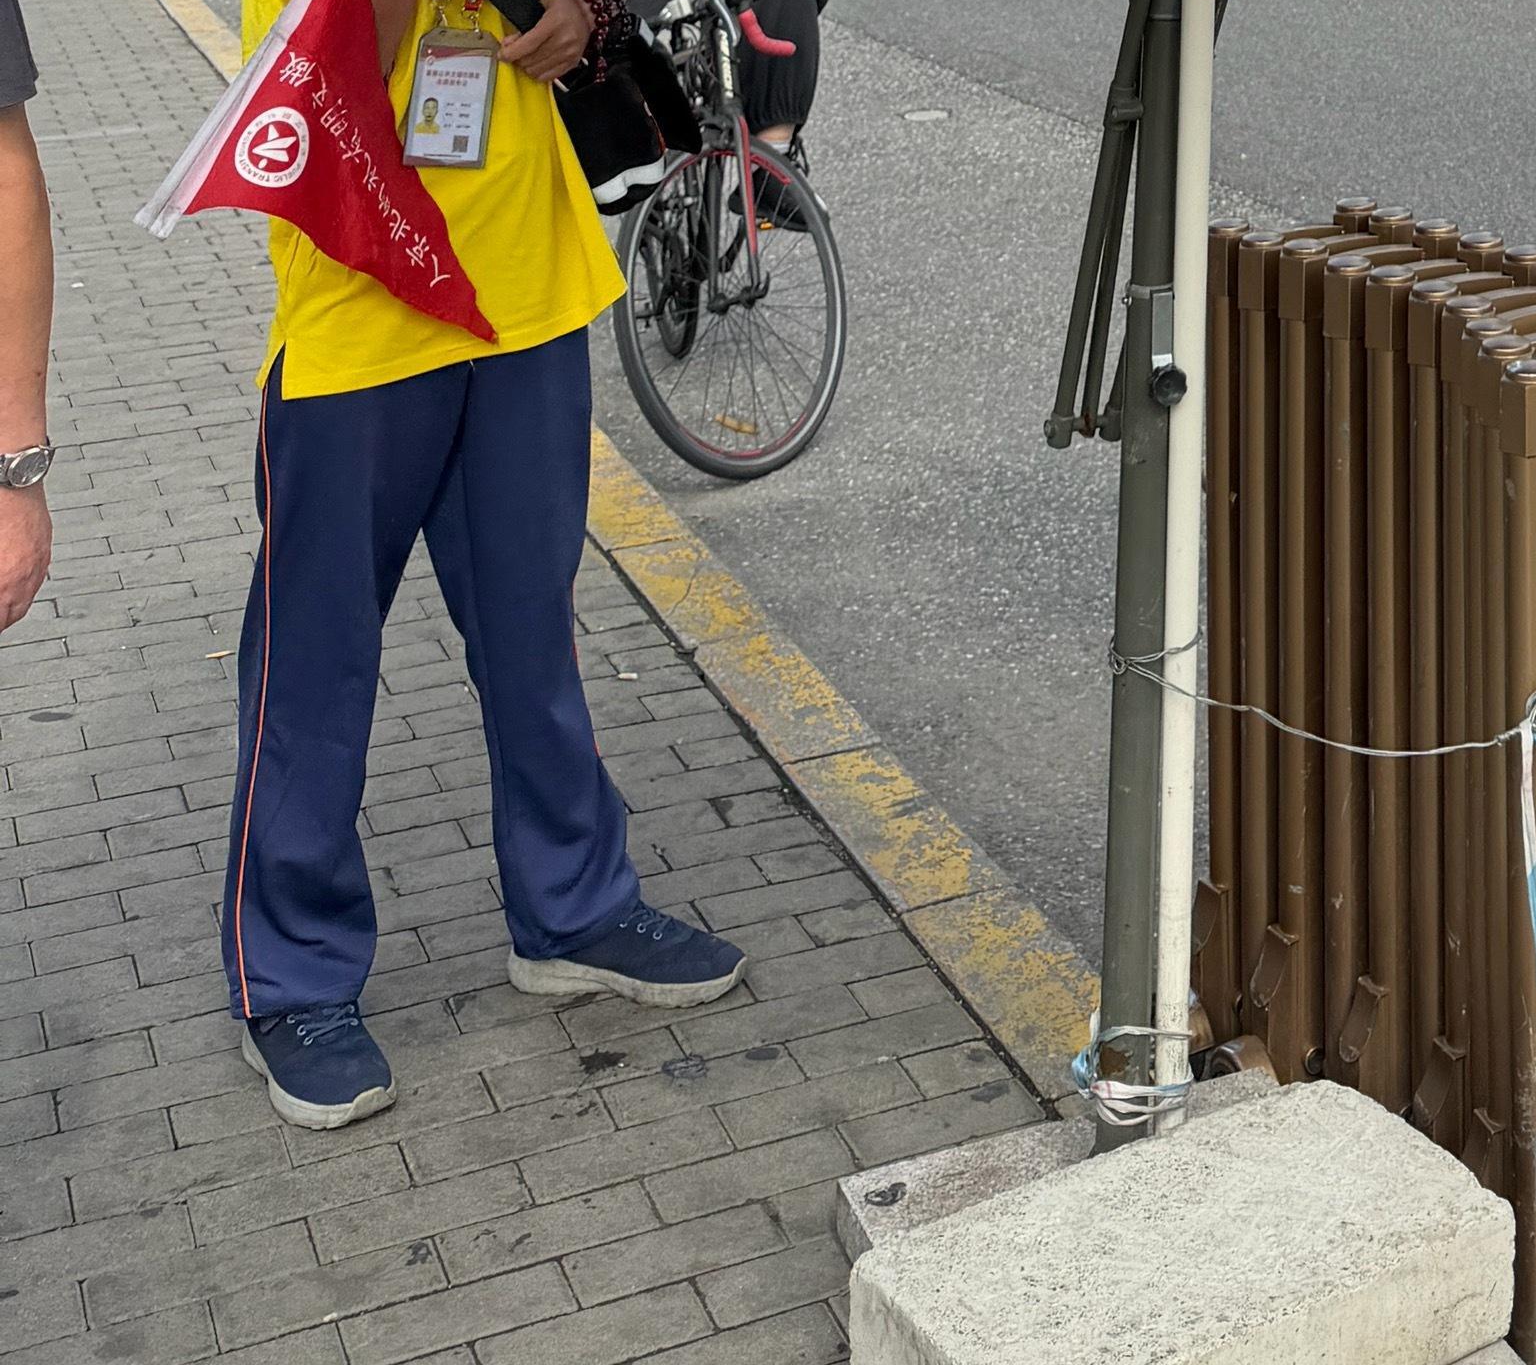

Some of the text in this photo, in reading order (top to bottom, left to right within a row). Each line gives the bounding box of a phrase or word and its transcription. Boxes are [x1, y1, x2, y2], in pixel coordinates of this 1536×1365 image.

[279, 51, 452, 289] 做文明有礼的北京人
